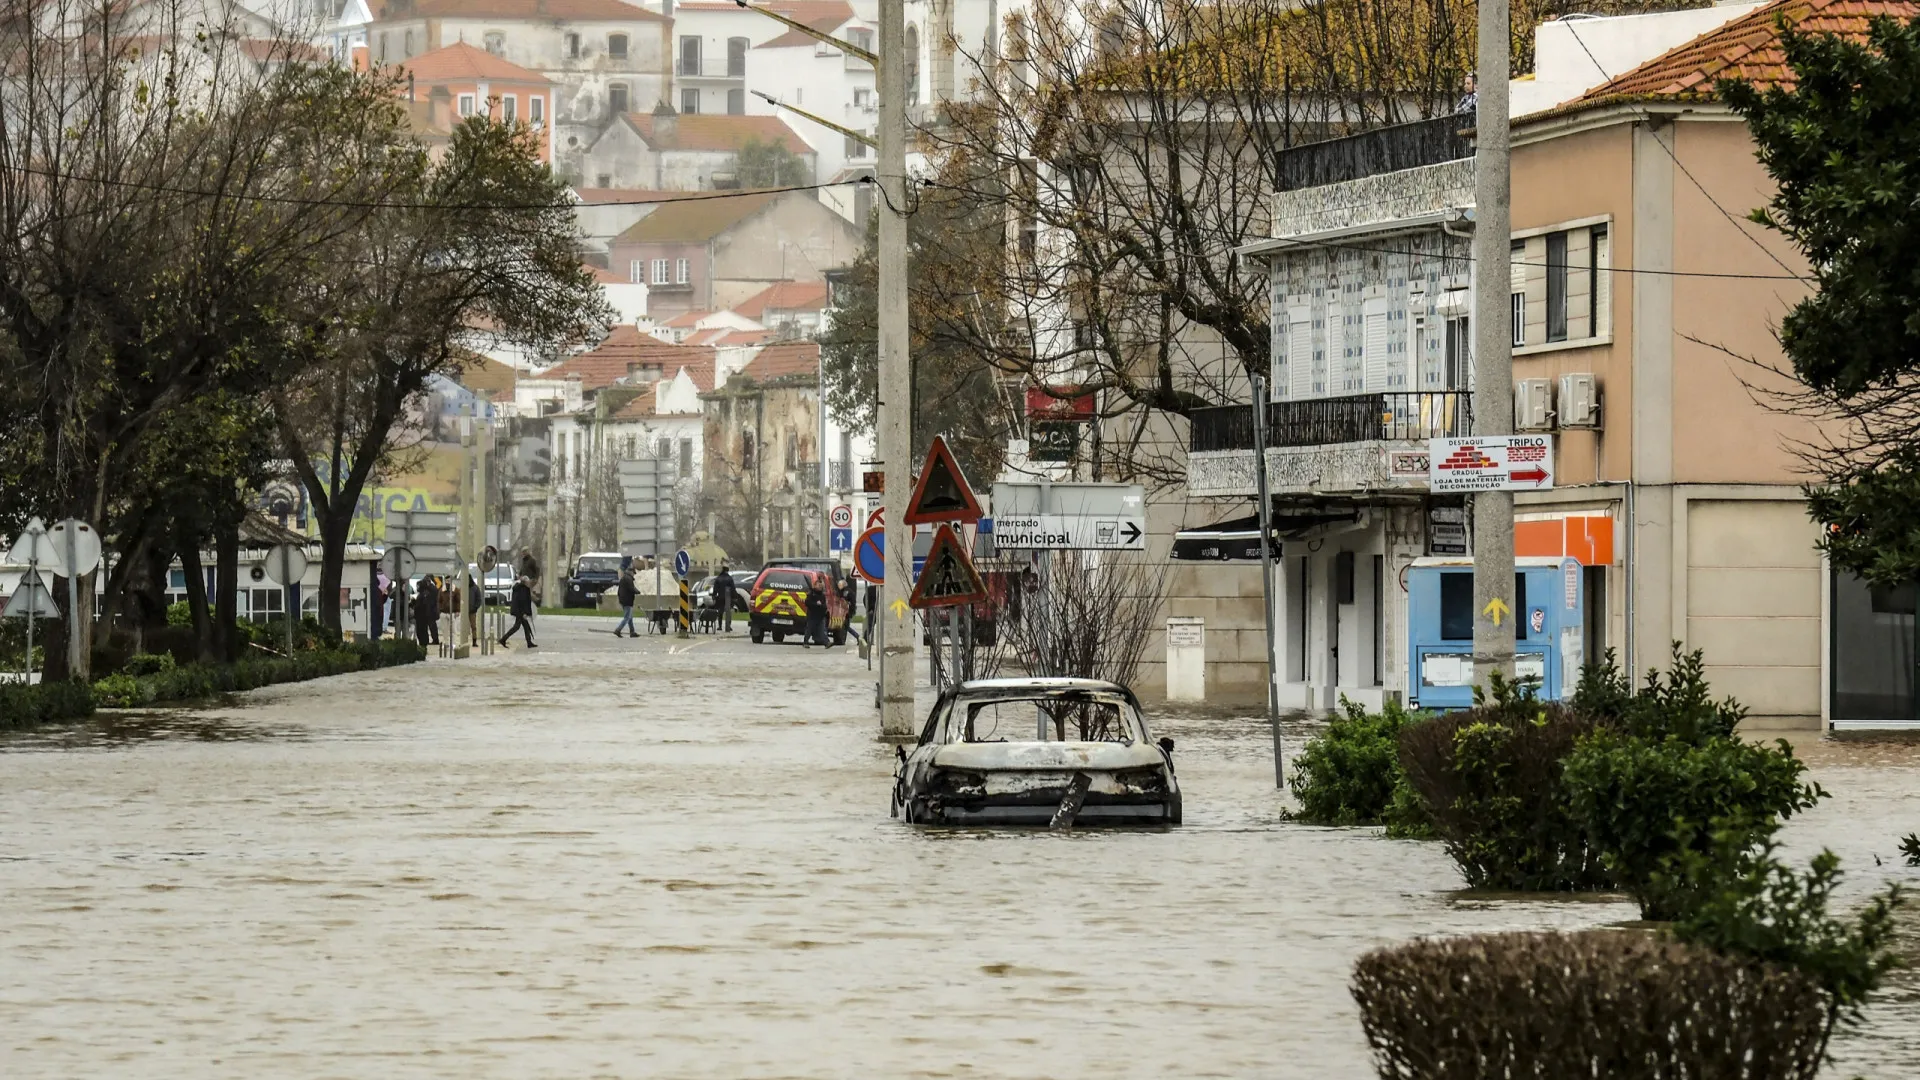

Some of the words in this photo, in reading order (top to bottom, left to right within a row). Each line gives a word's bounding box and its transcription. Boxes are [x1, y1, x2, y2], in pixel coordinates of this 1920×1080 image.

[1508, 438, 1544, 447] TRIPLO
[834, 512, 849, 521] 30
[996, 519, 1039, 528] mercado
[996, 531, 1071, 546] municipal
[770, 582, 803, 590] COMANDO
